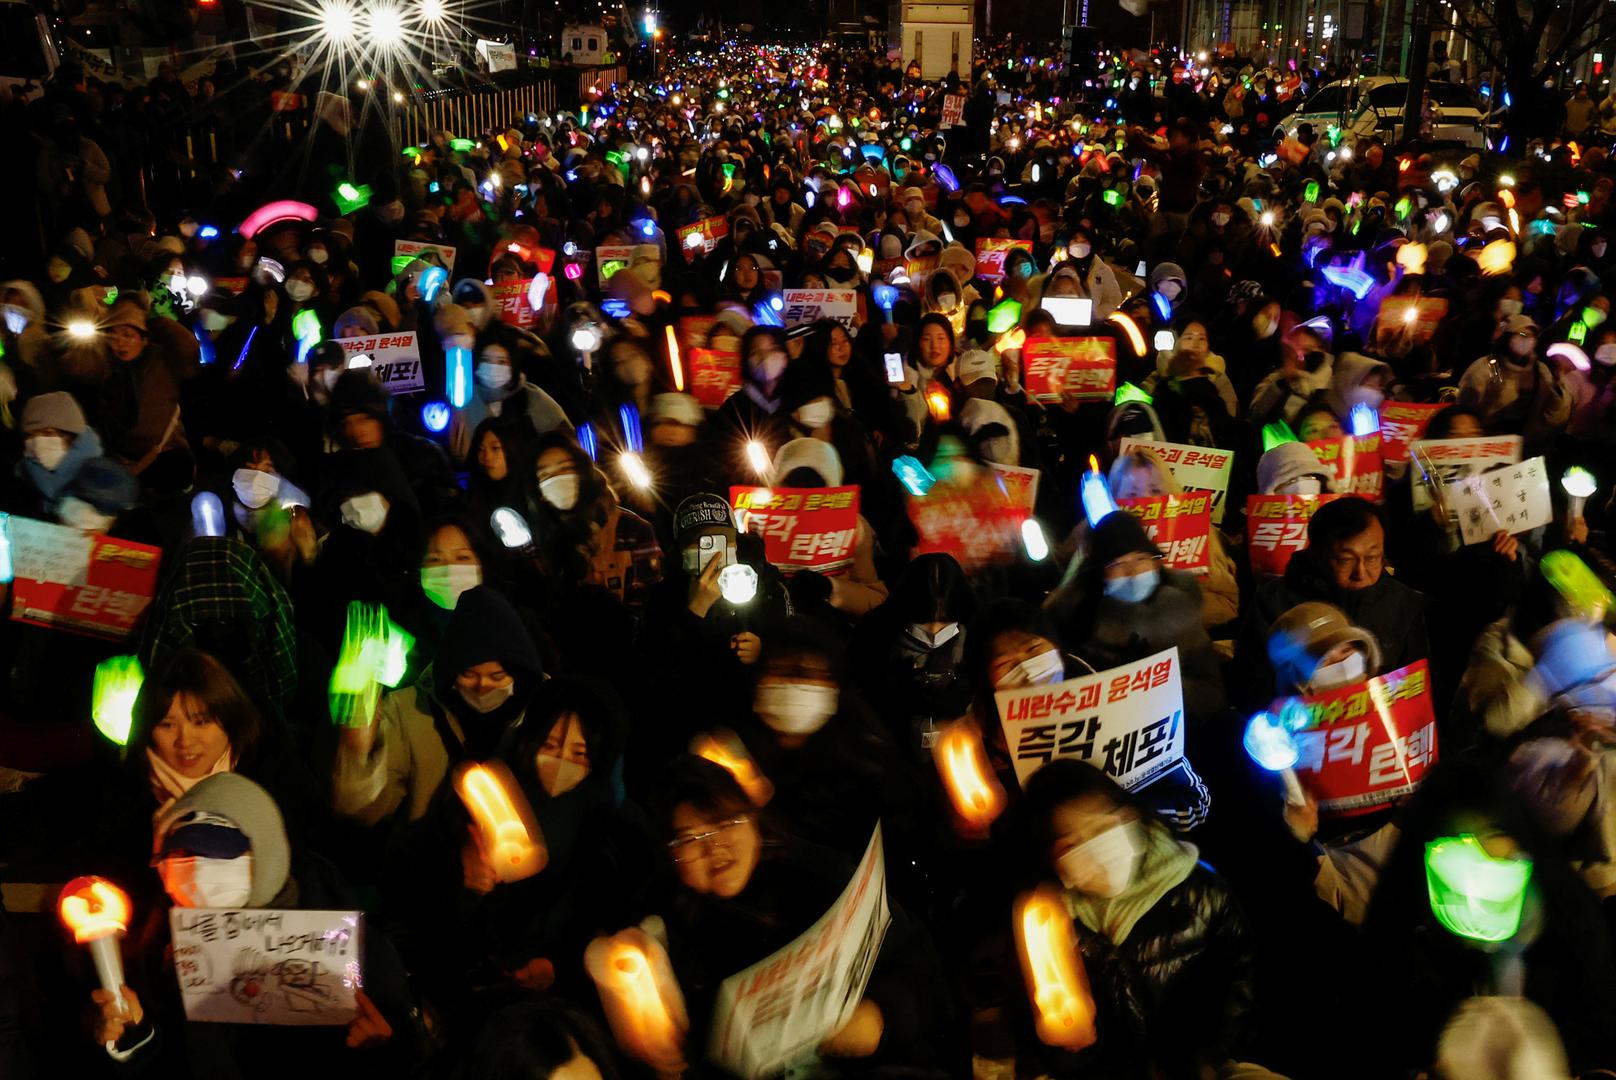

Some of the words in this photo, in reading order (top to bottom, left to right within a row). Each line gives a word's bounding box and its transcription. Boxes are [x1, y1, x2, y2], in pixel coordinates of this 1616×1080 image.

[786, 293, 824, 303] 내란수괴
[786, 305, 822, 321] 즉각
[379, 335, 413, 349] 윤석열
[375, 361, 419, 383] 체포!
[1182, 451, 1229, 470] 윤석열
[804, 490, 857, 511] 윤석열
[680, 508, 712, 529] CHERISH
[788, 528, 856, 561] 탄핵!
[1006, 682, 1102, 721] 내란수괴
[1107, 657, 1172, 705] 윤석열
[1018, 716, 1102, 761] 즉각
[1102, 709, 1182, 777] 체포!
[1369, 721, 1435, 787] 탄핵!
